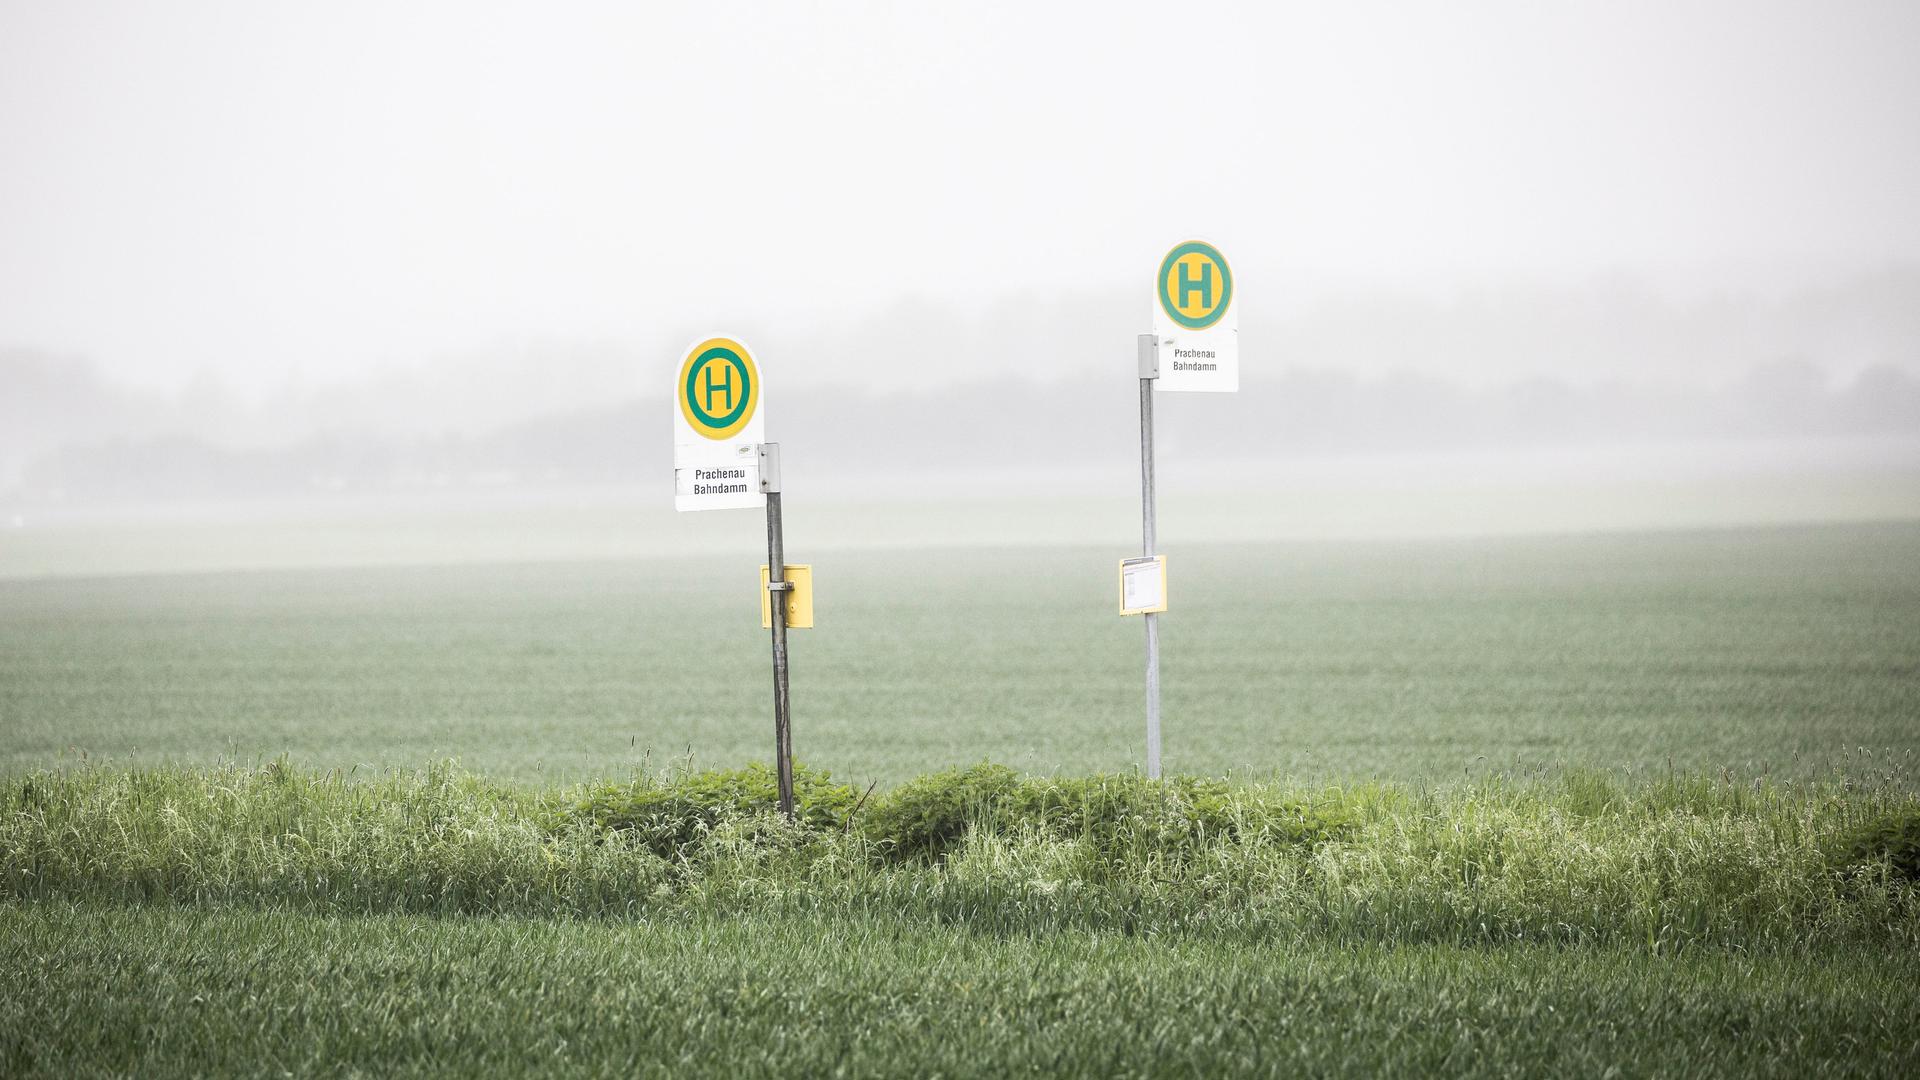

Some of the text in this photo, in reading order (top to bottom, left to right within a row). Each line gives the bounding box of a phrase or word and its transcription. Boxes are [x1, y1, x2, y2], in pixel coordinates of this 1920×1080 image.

[1178, 262, 1212, 309] H
[1174, 348, 1216, 359] Prachenau
[1173, 361, 1217, 371] Bahndamm
[705, 365, 732, 411] H
[695, 468, 745, 480] Prachenau
[694, 483, 747, 495] Bahndamm
